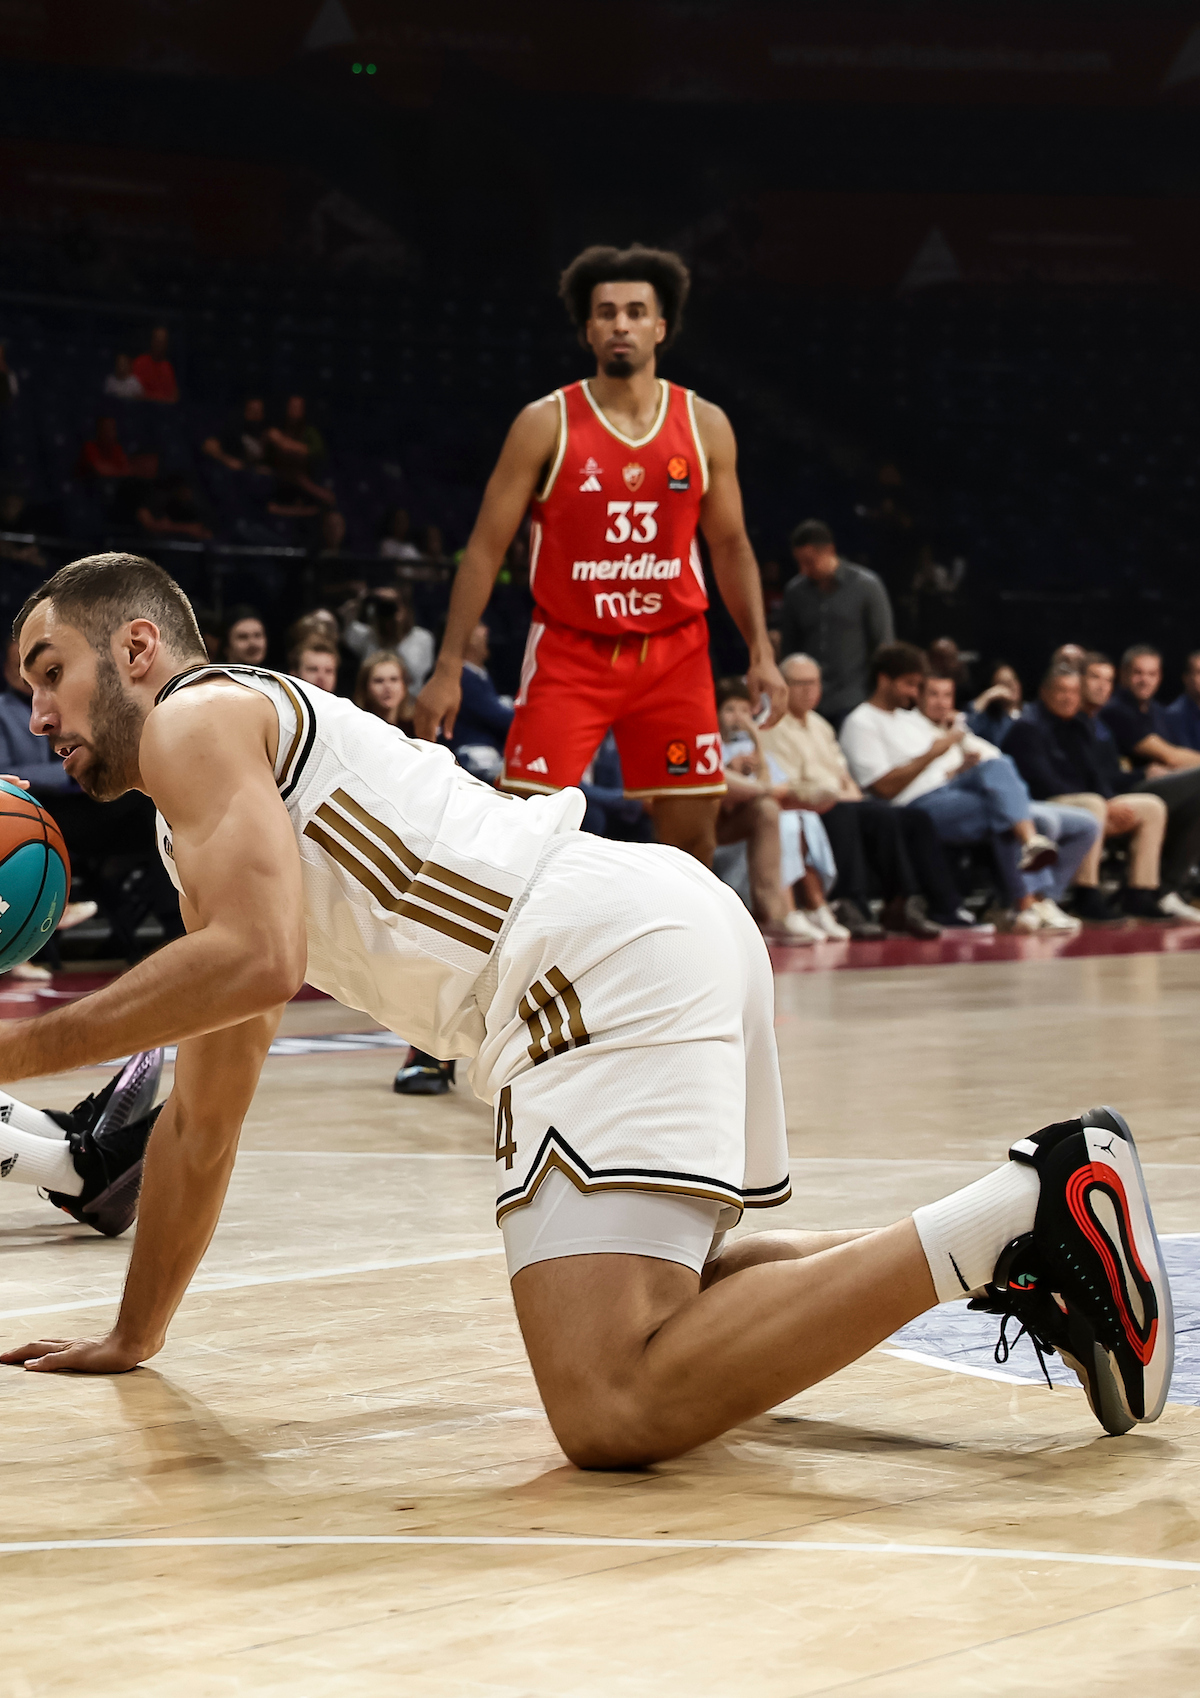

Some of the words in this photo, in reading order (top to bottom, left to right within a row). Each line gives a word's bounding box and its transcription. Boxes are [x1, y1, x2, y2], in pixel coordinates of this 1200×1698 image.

[605, 501, 658, 543] 33
[572, 553, 681, 581] meridian
[594, 587, 663, 619] mts
